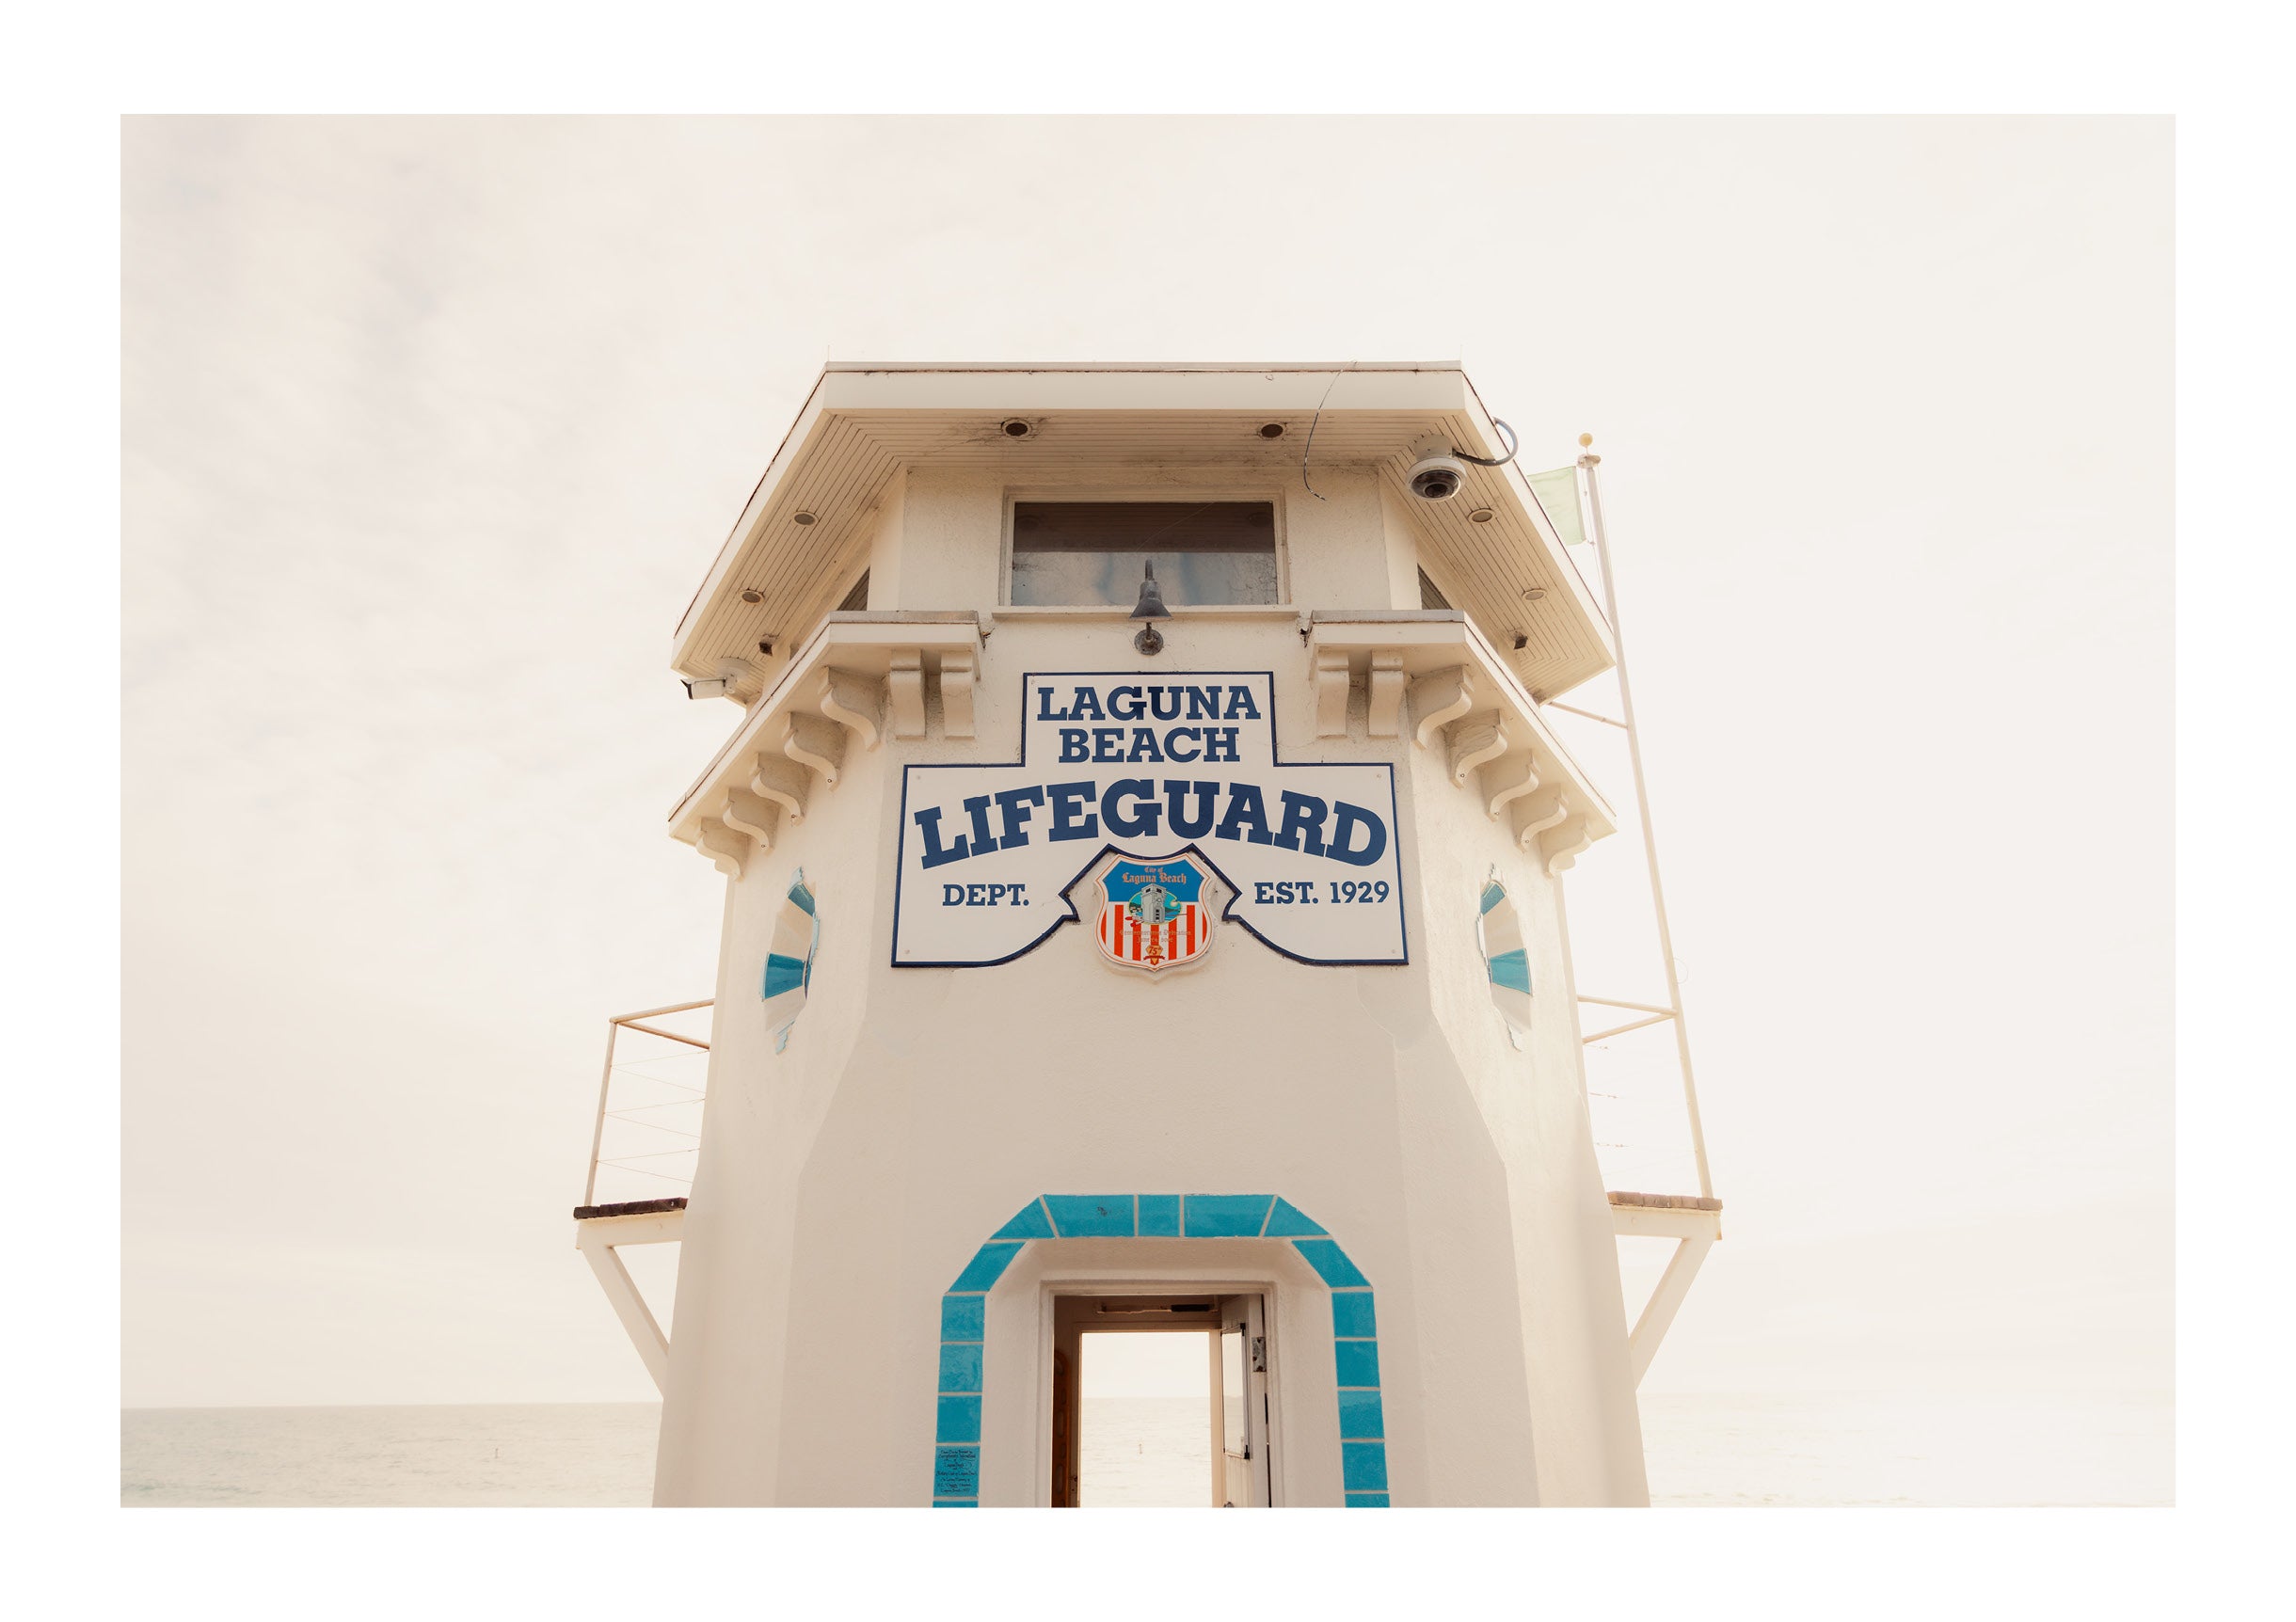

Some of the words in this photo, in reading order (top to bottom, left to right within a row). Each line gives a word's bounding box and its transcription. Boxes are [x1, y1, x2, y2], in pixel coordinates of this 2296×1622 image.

[1037, 685, 1261, 722] LAGUNA
[1059, 726, 1241, 763] BEACH
[914, 778, 1387, 869] LIFEGUARD
[1123, 872, 1156, 884] Laguna
[1159, 872, 1187, 884] Beach
[1253, 881, 1319, 904] EST.
[1330, 880, 1390, 904] 1929
[942, 883, 1029, 907] DEPT.
